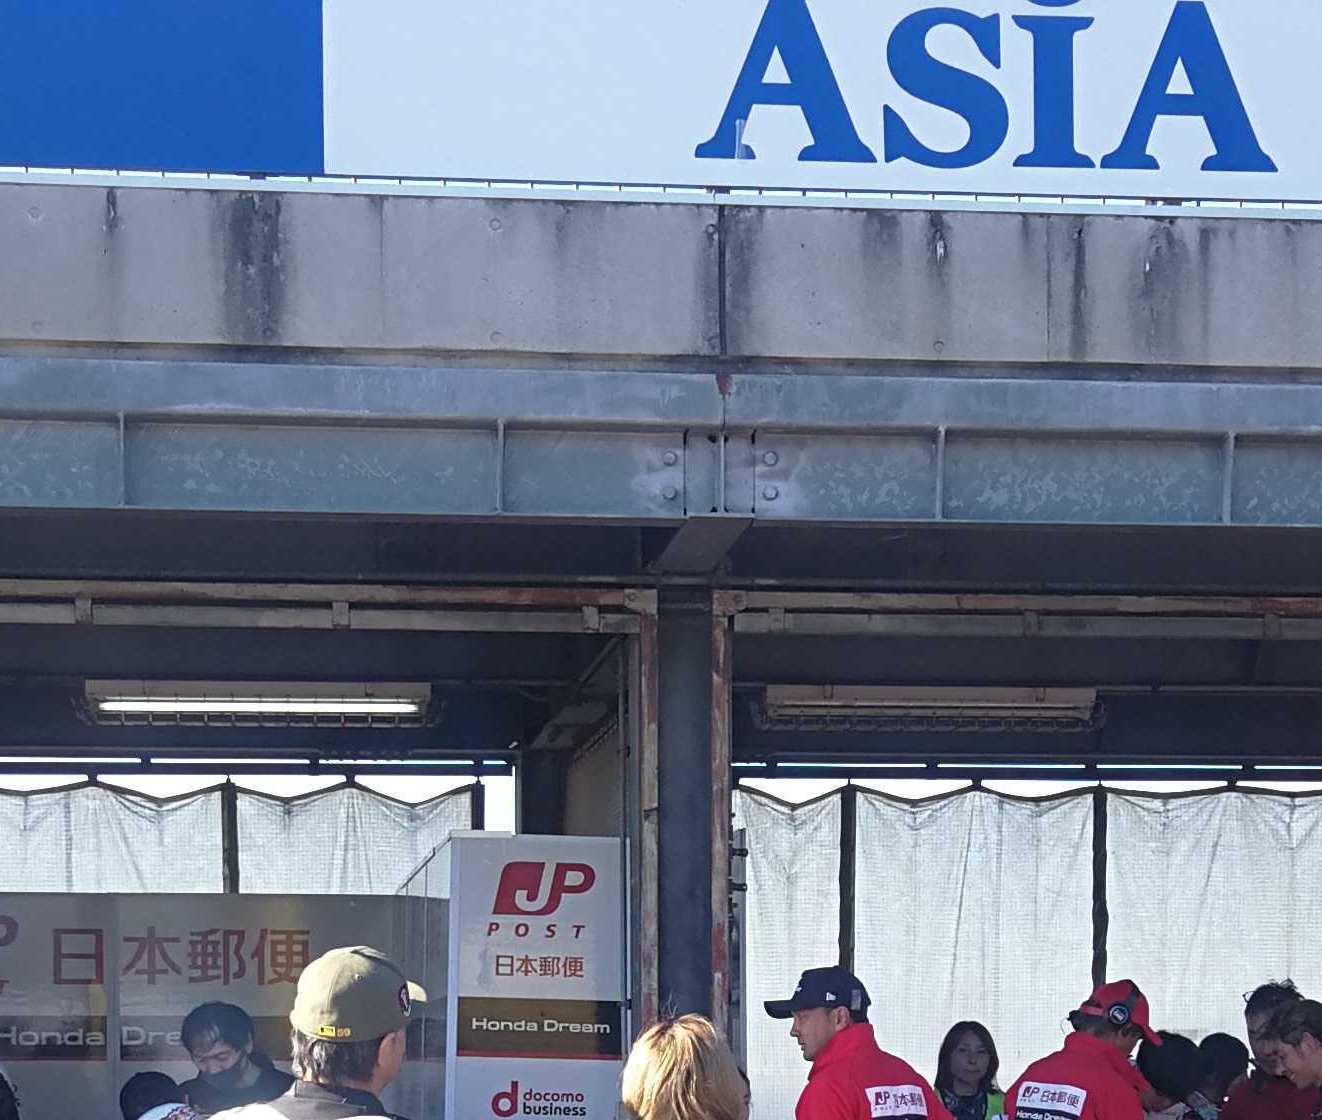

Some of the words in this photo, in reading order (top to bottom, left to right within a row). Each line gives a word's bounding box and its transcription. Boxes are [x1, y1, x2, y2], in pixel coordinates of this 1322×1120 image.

[695, 0, 1278, 172] ASIA
[487, 922, 585, 938] POST
[52, 926, 311, 985] 日本郵便
[495, 955, 584, 978] 日本郵便
[471, 1017, 538, 1033] Honda
[543, 1019, 610, 1034] Dream
[123, 1027, 181, 1046] Dre
[523, 1089, 585, 1102] docomo
[523, 1104, 587, 1117] business
